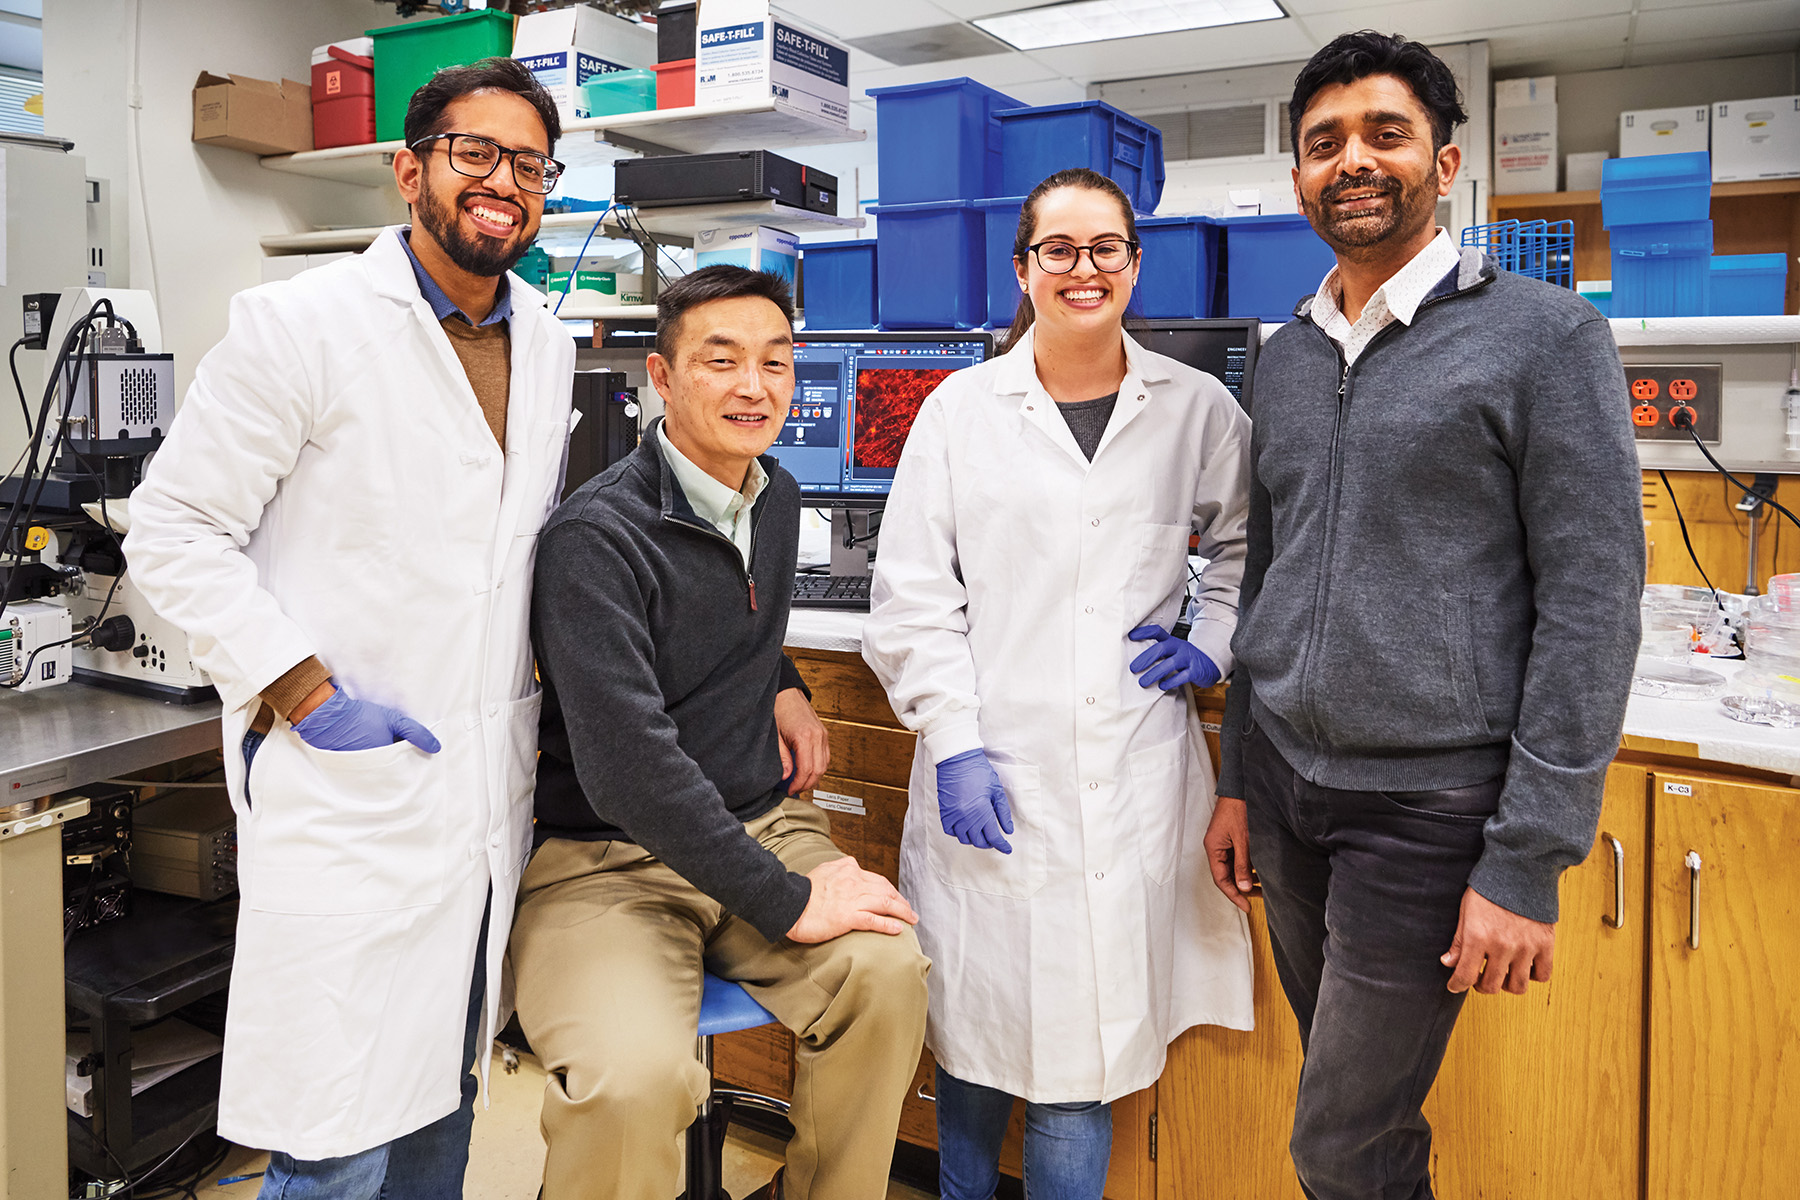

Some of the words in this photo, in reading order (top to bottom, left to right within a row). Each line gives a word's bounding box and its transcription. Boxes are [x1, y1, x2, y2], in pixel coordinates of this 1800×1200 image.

[702, 28, 755, 45] SAFE-T-FILL
[777, 28, 829, 60] SAFE-T-FILL
[521, 57, 560, 69] AFE-T-FILL
[729, 232, 753, 240] eppendorf
[620, 293, 643, 302] Kimw
[1667, 784, 1690, 794] K-C3
